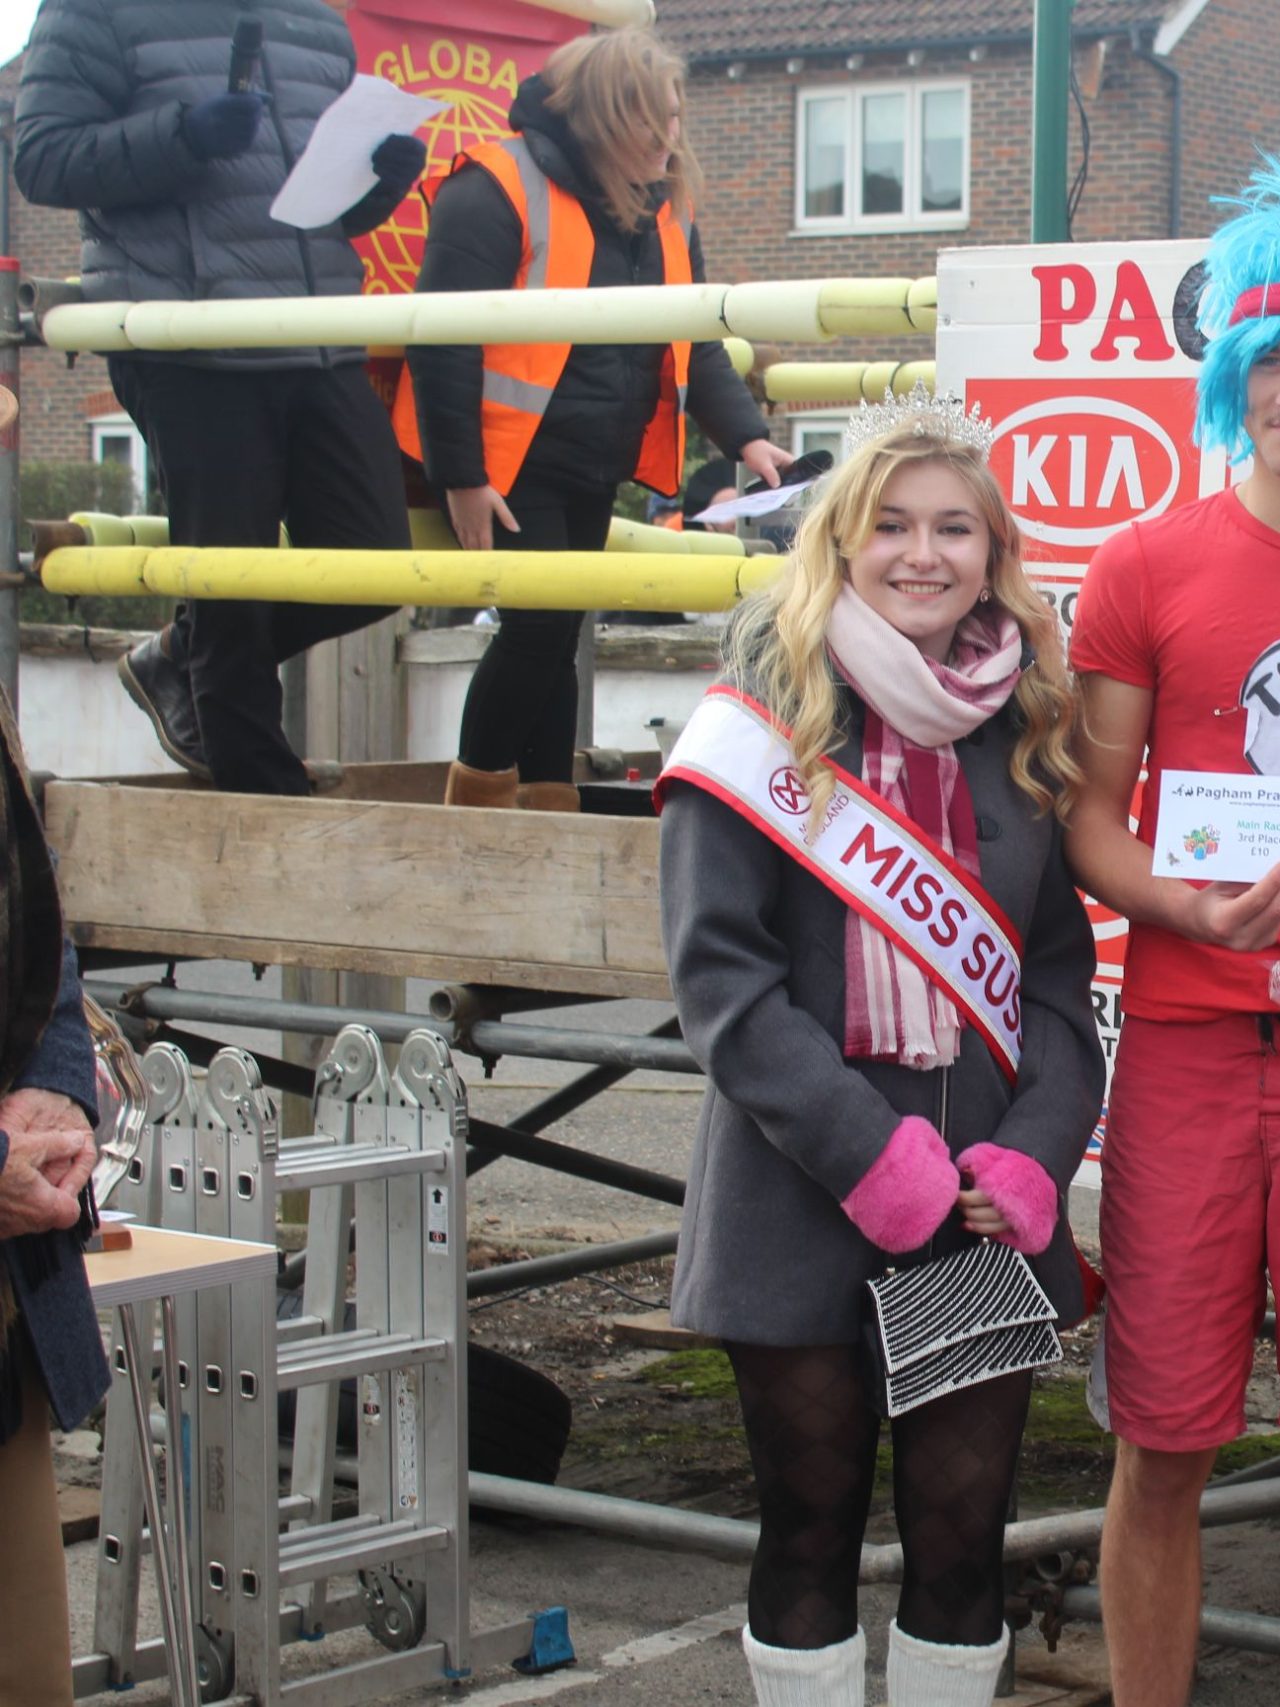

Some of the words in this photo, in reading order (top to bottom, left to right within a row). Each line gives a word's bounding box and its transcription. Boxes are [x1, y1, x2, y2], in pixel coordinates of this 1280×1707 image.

[1012, 434, 1146, 509] KIA
[1196, 786, 1253, 801] Pagham
[1237, 820, 1260, 831] Main
[1238, 832, 1255, 844] 3rd
[1250, 846, 1270, 858] £10
[839, 822, 969, 948] MISS
